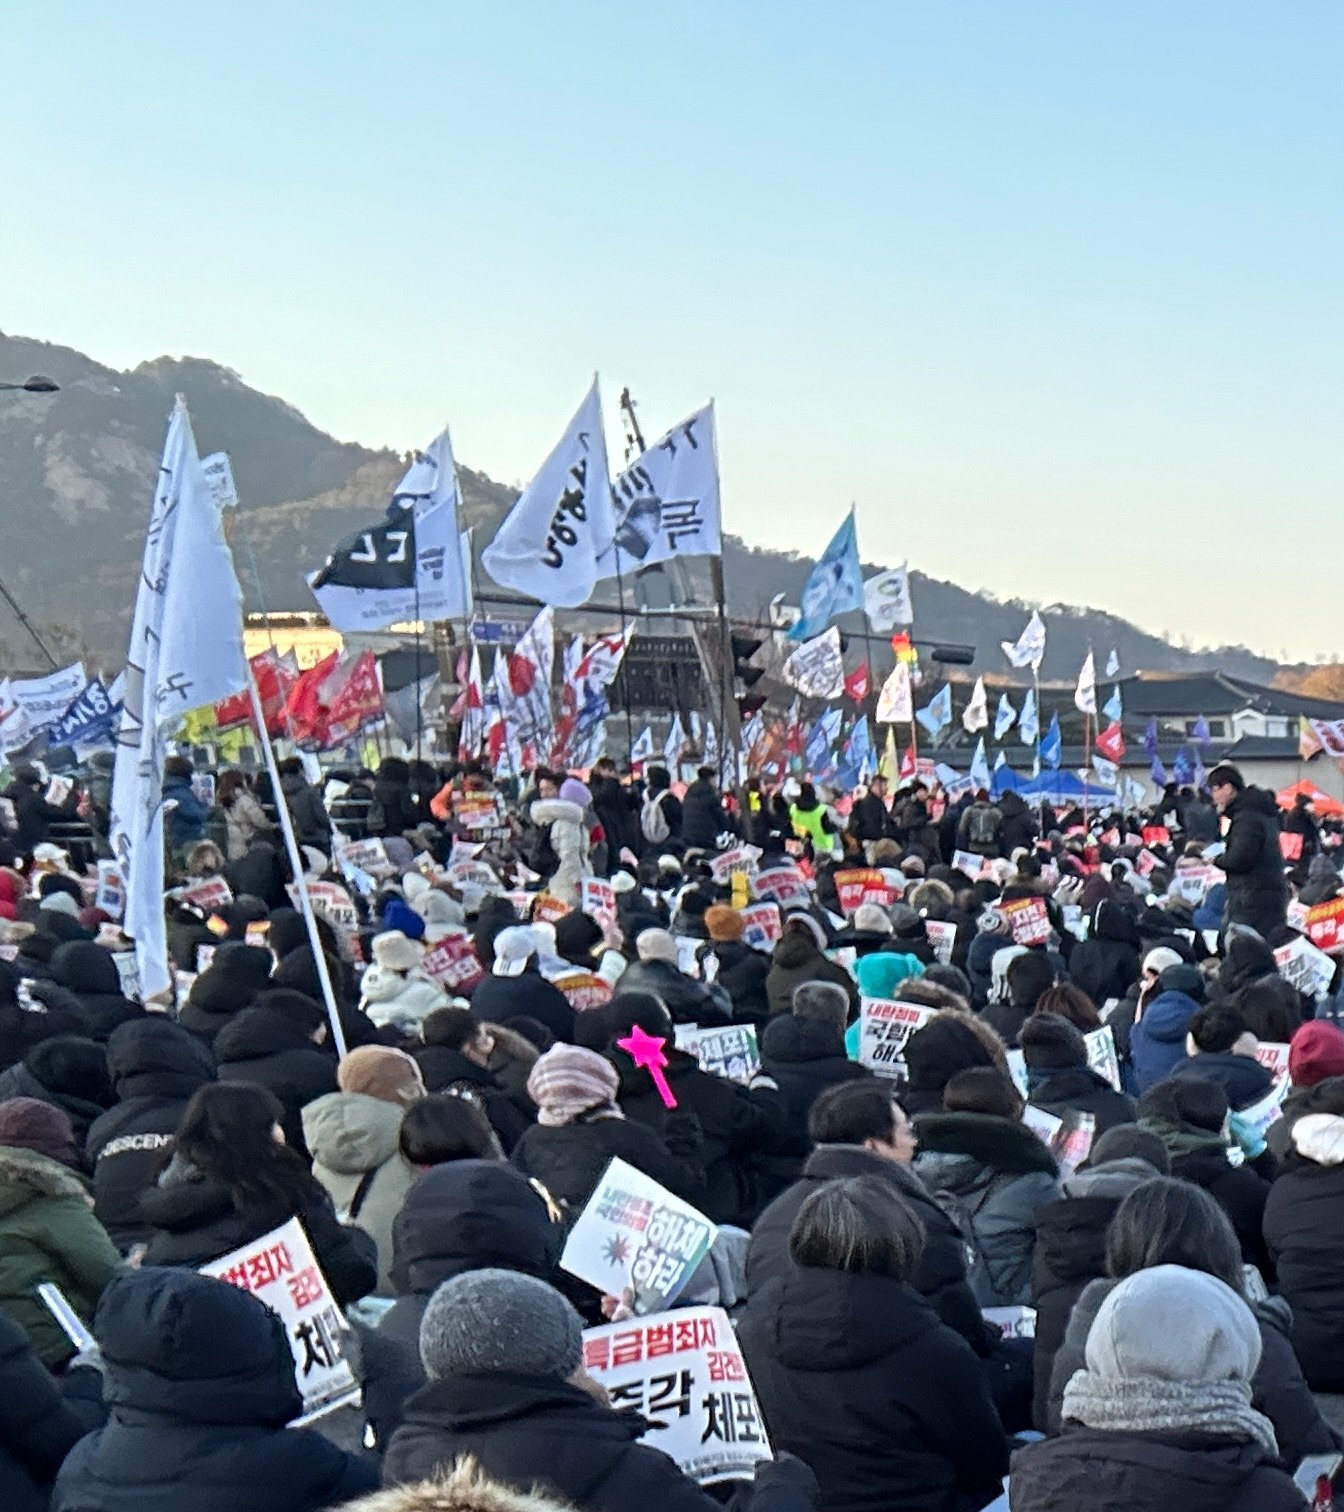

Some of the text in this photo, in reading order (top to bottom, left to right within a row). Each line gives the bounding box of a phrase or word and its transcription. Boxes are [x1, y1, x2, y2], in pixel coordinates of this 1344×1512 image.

[647, 1206, 710, 1262] 해체
[633, 1245, 686, 1298] 하라
[584, 1317, 717, 1371] 특급범죄자
